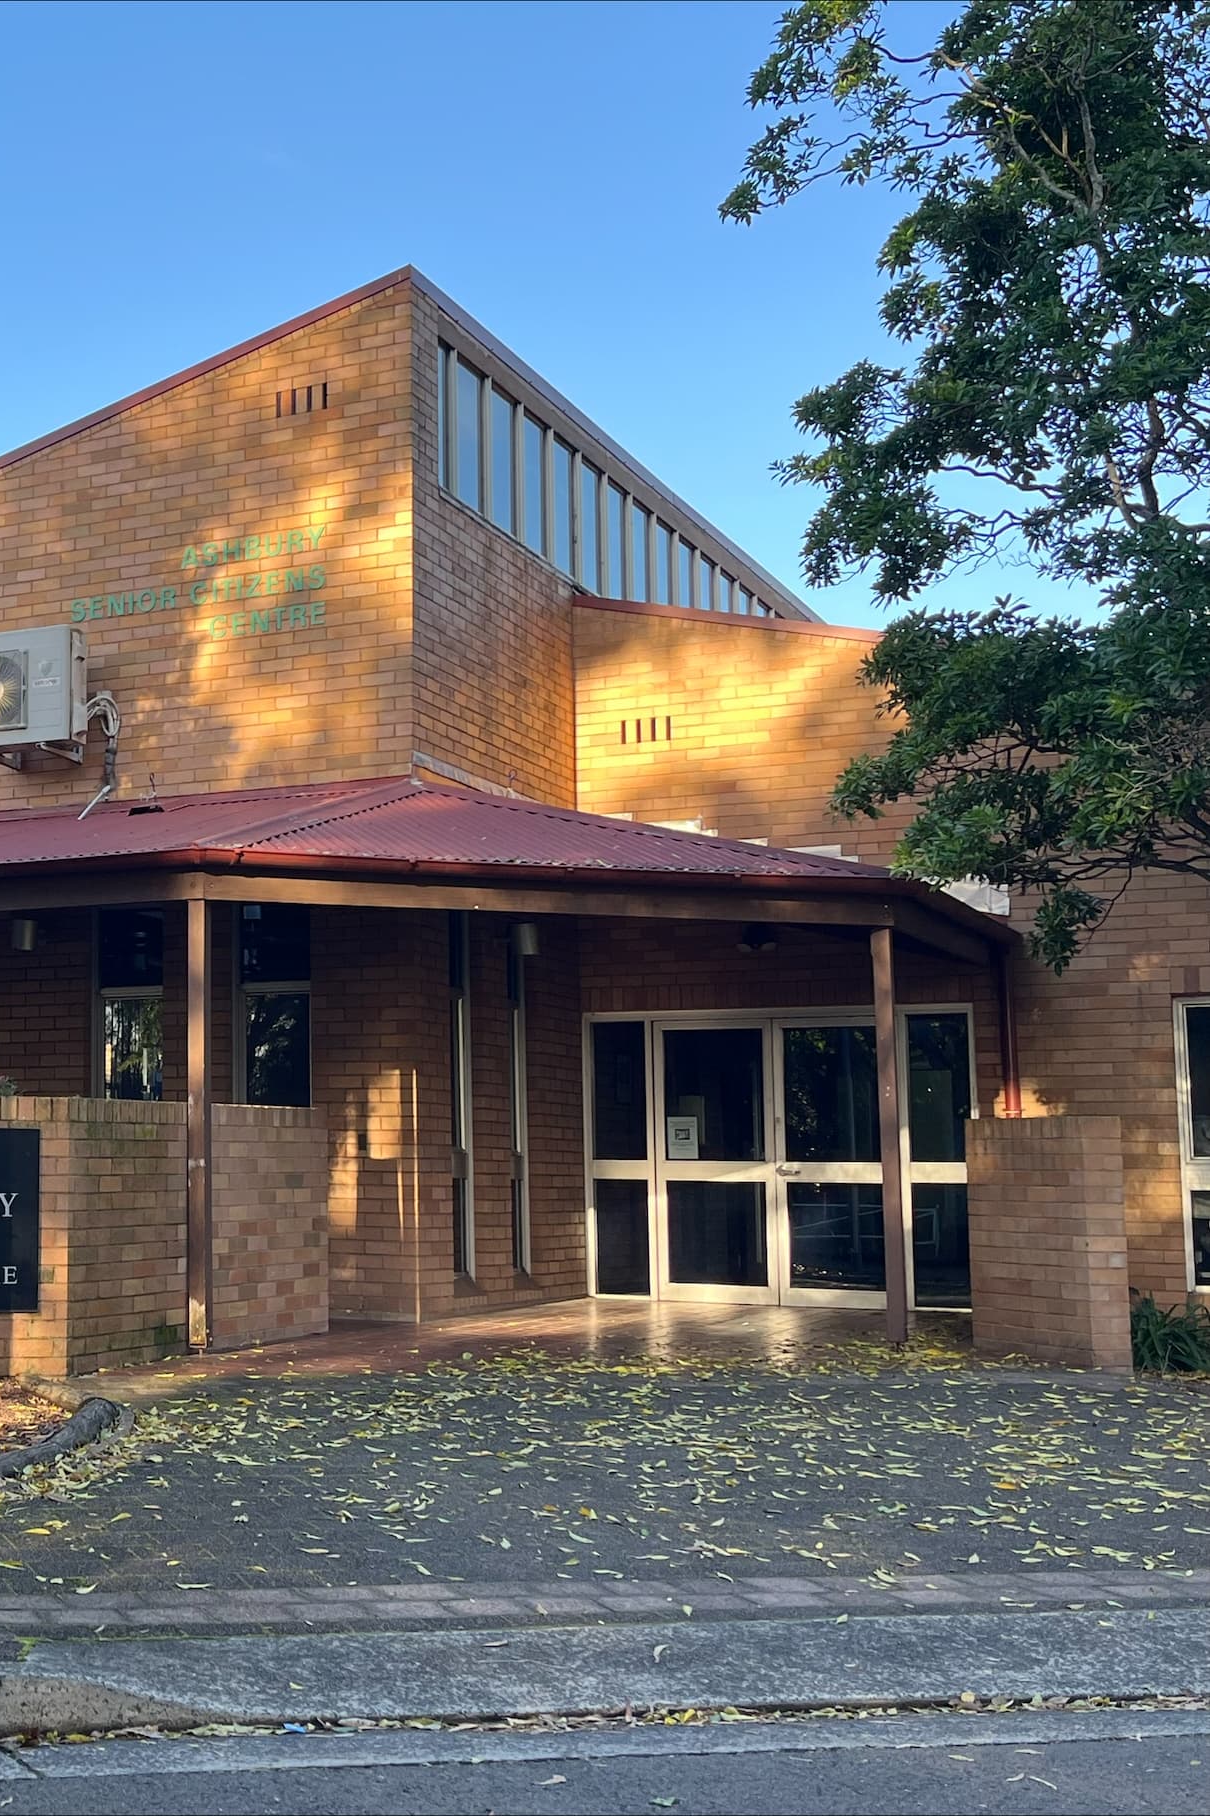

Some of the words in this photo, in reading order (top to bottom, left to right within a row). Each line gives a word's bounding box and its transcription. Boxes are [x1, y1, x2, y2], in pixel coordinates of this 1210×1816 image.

[180, 525, 326, 570] ASHBURY
[70, 586, 177, 623] SENIOR
[190, 565, 327, 606] CITIZENS
[209, 601, 327, 639] CENTRE
